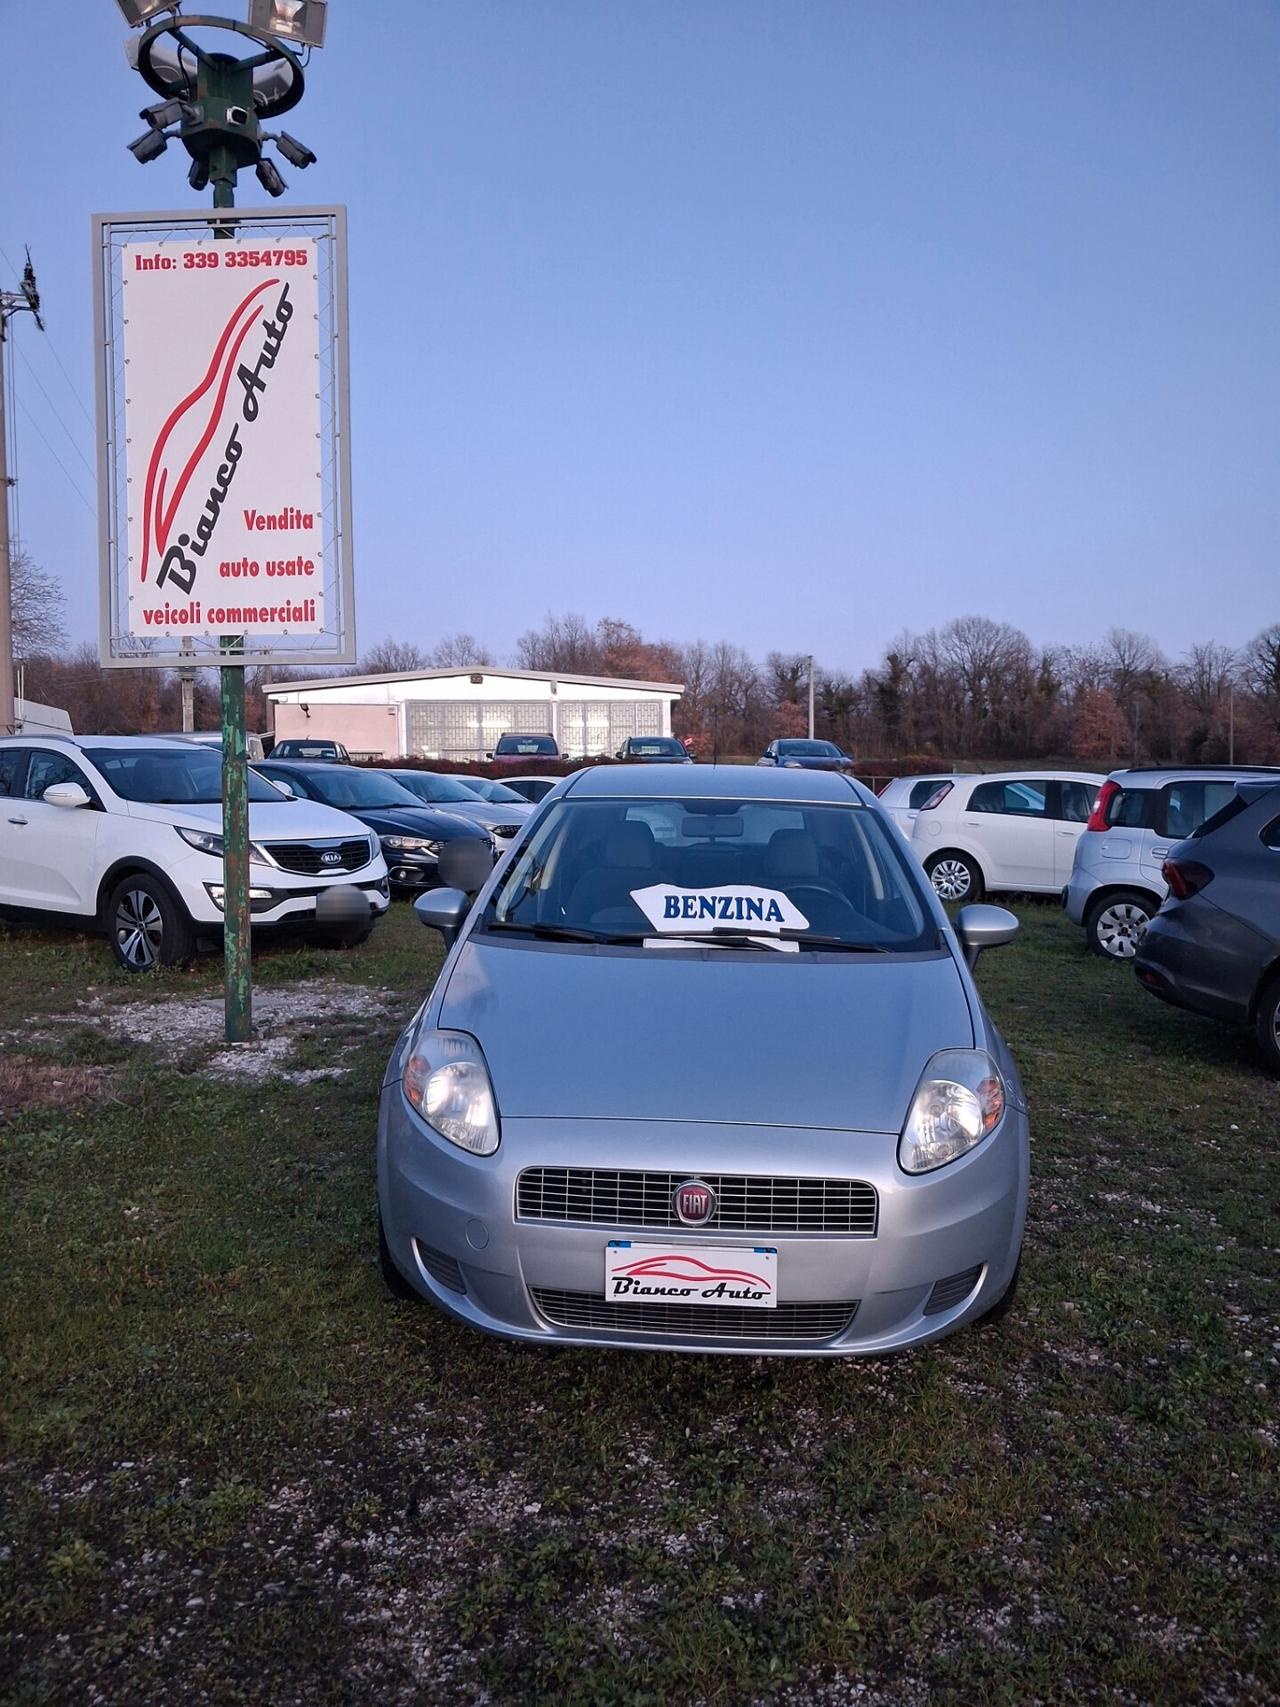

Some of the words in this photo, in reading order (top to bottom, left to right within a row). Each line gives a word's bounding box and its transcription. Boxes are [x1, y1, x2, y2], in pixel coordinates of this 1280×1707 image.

[135, 253, 177, 271] Info:
[183, 251, 219, 270] 339
[225, 249, 308, 268] 3354795
[155, 422, 243, 595] Bianco
[236, 282, 294, 423] Auto
[244, 507, 314, 531] Vendita
[219, 557, 260, 579] auto
[265, 556, 315, 577] usate
[143, 602, 201, 625] veicoli
[207, 599, 316, 624] commerciali
[324, 854, 339, 862] KIA
[663, 895, 785, 922] BENZINA
[683, 1194, 707, 1211] FIAT
[612, 1276, 698, 1297] Bianco
[701, 1282, 771, 1300] Auto
